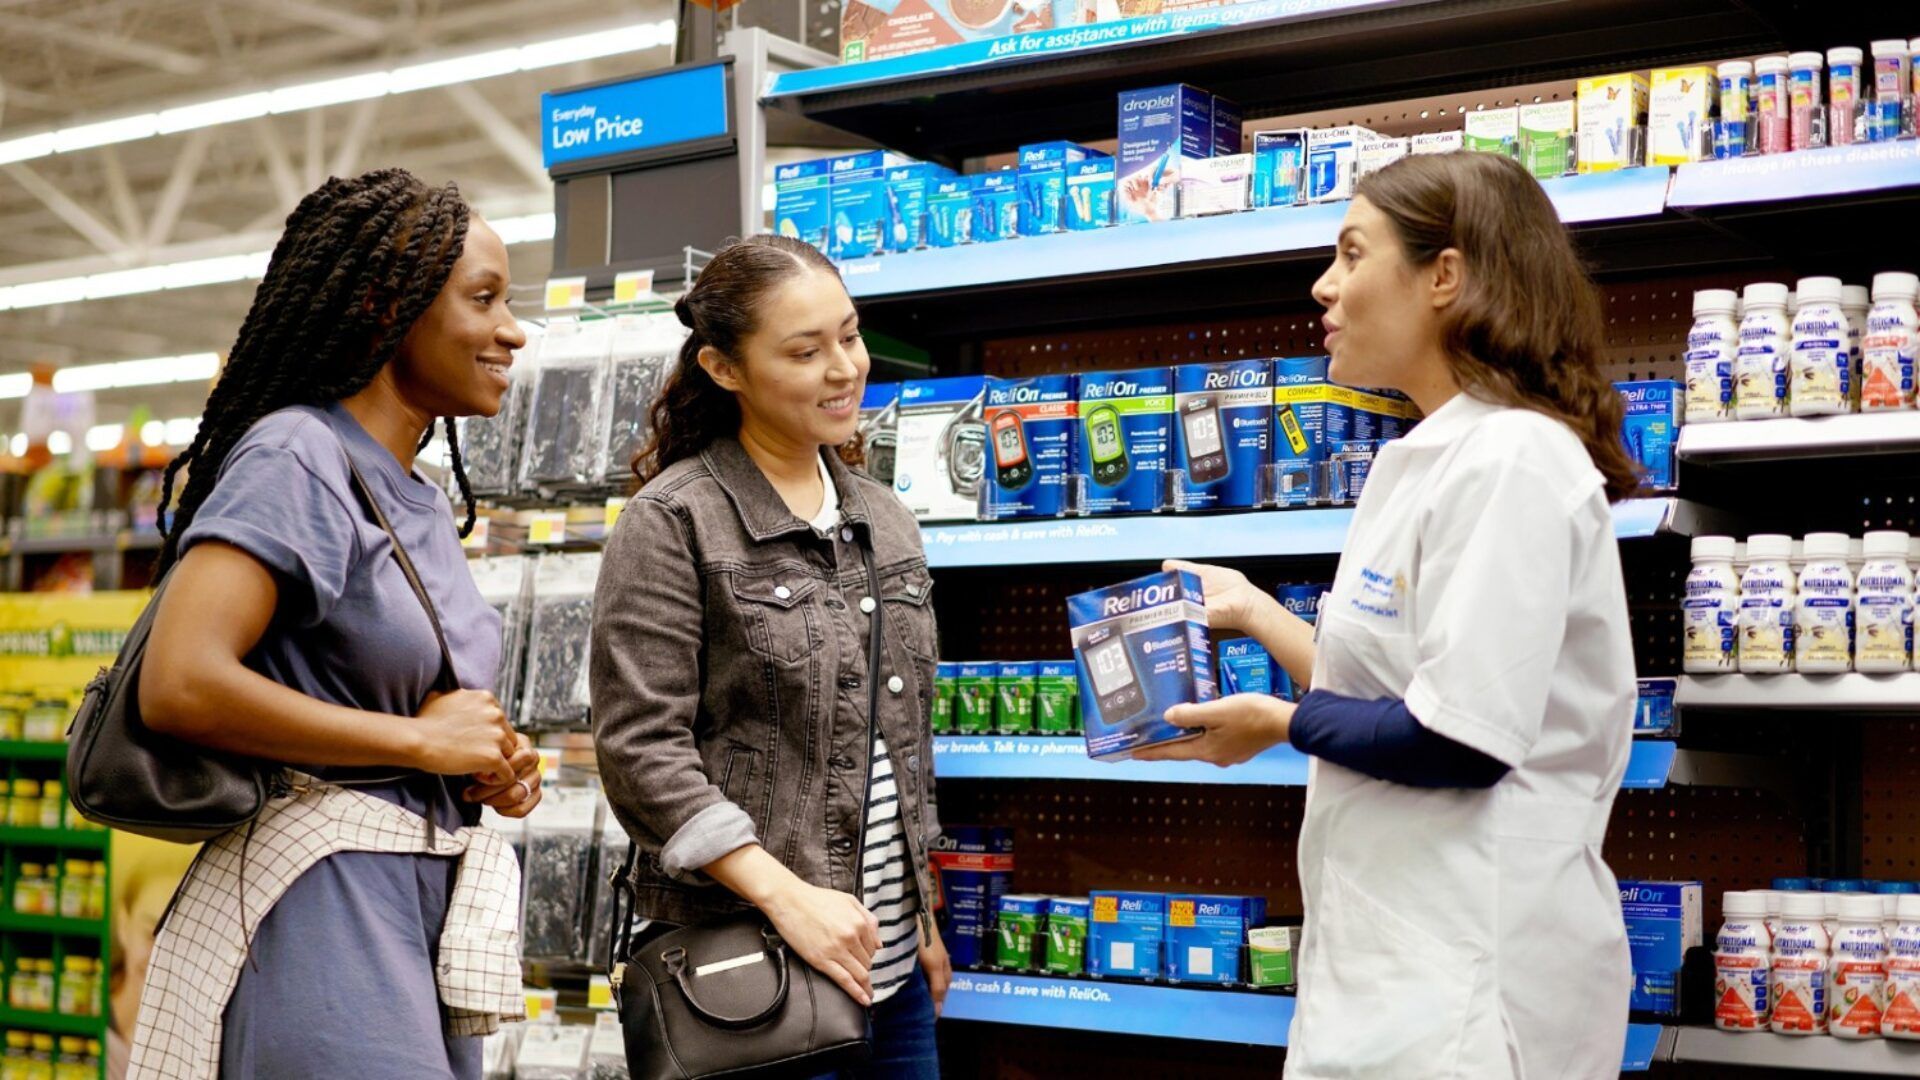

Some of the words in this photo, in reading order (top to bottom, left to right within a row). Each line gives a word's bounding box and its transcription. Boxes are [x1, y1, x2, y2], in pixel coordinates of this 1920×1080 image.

[988, 38, 1016, 56] Ask
[1020, 33, 1042, 50] for
[1045, 23, 1127, 48] assistance
[1131, 17, 1167, 36] with
[1171, 10, 1217, 29] items
[1221, 9, 1242, 22] on
[1123, 94, 1175, 111] droplet
[552, 104, 597, 121] Everyday
[552, 126, 590, 148] Low
[595, 116, 643, 142] Price
[1722, 160, 1778, 175] Indulge
[1782, 157, 1796, 169] in
[1800, 152, 1842, 167] these
[1204, 369, 1267, 389] ReliOn
[989, 387, 1039, 403] ReliOn
[1084, 382, 1138, 398] ReliOn
[1287, 386, 1322, 397] COMPACT
[1192, 414, 1217, 440] 103
[958, 530, 981, 542] with
[984, 530, 1008, 541] cash
[1022, 529, 1046, 540] save
[1049, 526, 1073, 538] with
[1104, 584, 1176, 616] ReliOn
[1095, 641, 1127, 676] 103
[951, 741, 990, 753] brands.
[994, 741, 1015, 753] Talk
[1018, 742, 1030, 753] to
[1032, 745, 1040, 753] a
[1120, 900, 1158, 911] ReliOn
[1198, 903, 1239, 916] ReliOn
[949, 978, 973, 991] with
[975, 979, 1000, 994] cash
[1003, 982, 1012, 994] &
[1014, 985, 1038, 997] save
[1041, 984, 1066, 999] with
[1069, 984, 1111, 1002] ReliOn.
